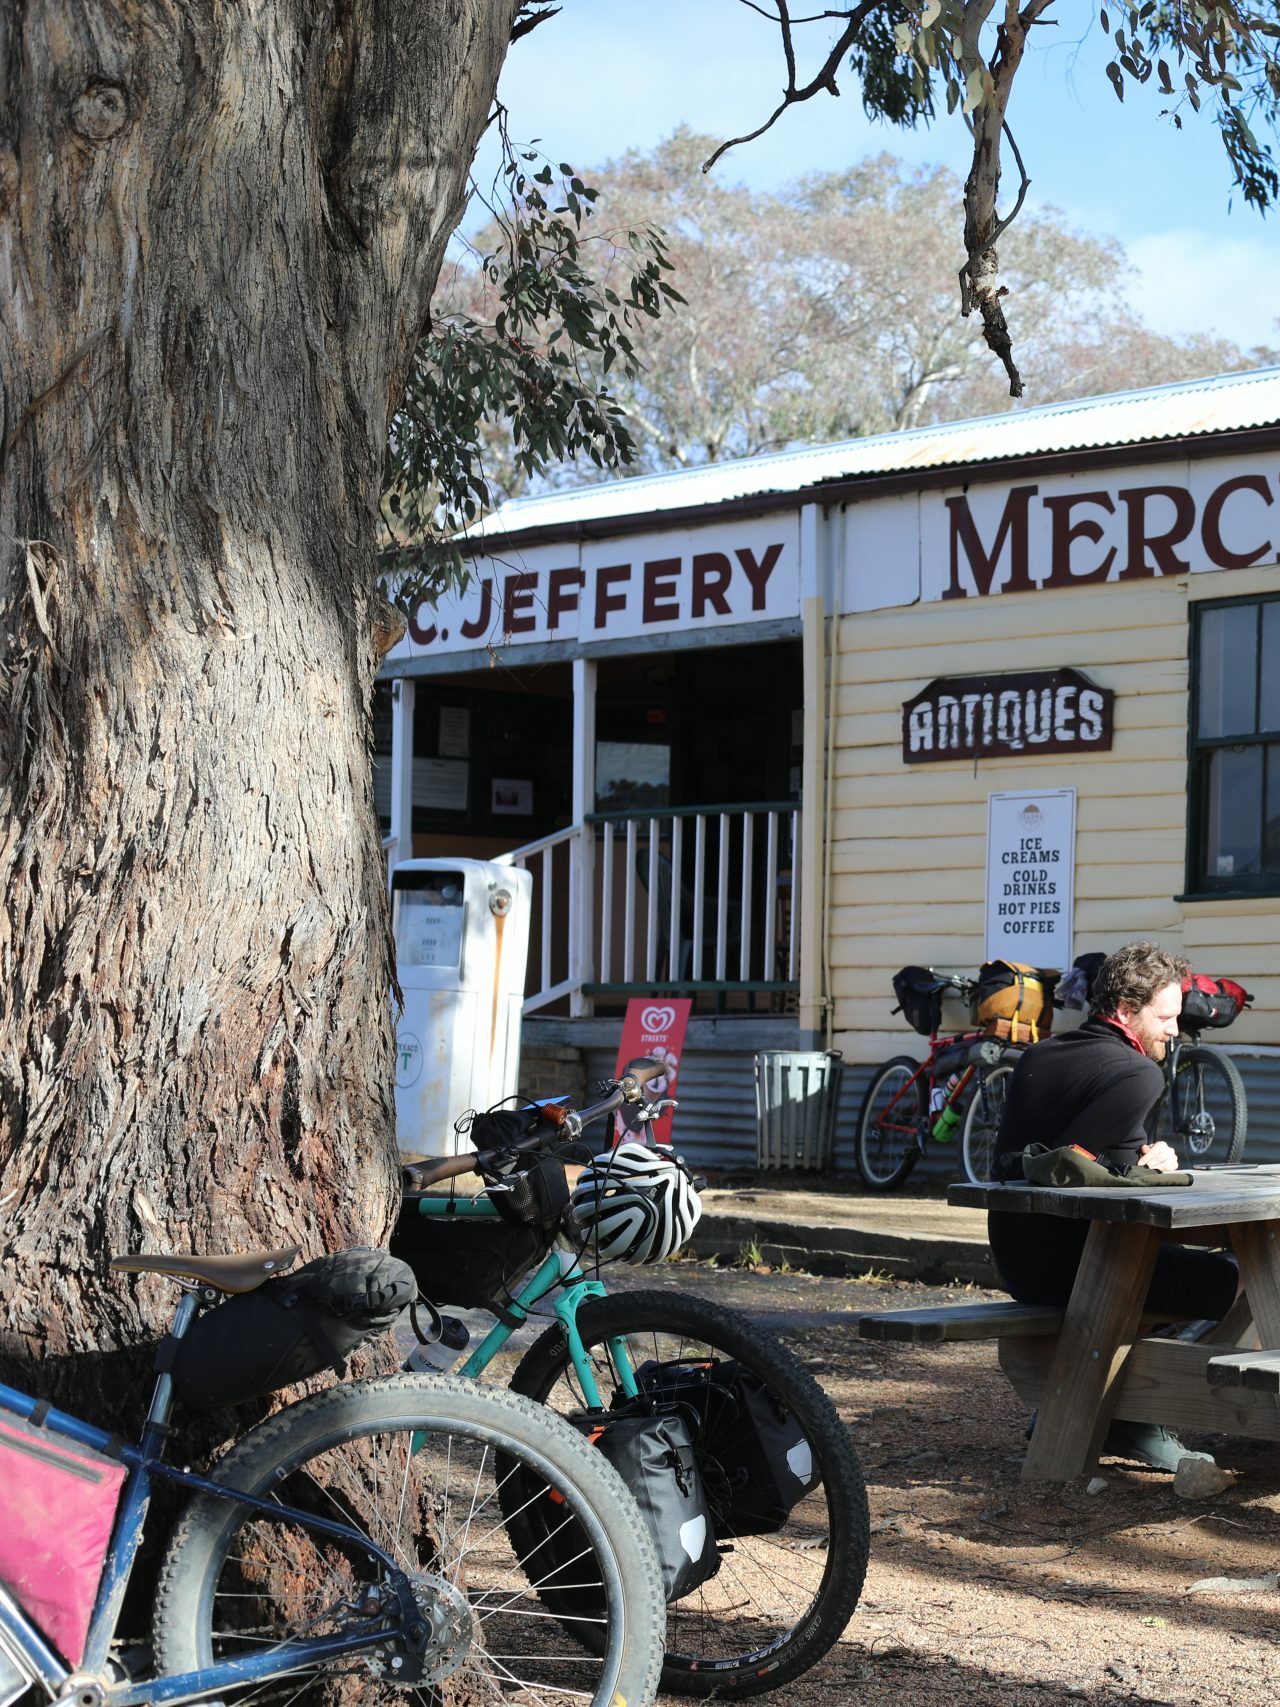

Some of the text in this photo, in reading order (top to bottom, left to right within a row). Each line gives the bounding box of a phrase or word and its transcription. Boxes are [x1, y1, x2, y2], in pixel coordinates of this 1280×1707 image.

[460, 543, 785, 639] JEFFERY
[909, 686, 1104, 752] ANTIQUES
[1020, 837, 1043, 851] ICE
[1001, 850, 1060, 865] CREAMS
[1012, 869, 1049, 883] COLD
[1003, 882, 1057, 897] DRINKS
[998, 901, 1061, 915] HOT PIES
[1003, 920, 1056, 934] COFFEE
[805, 1615, 822, 1640] CANIS
